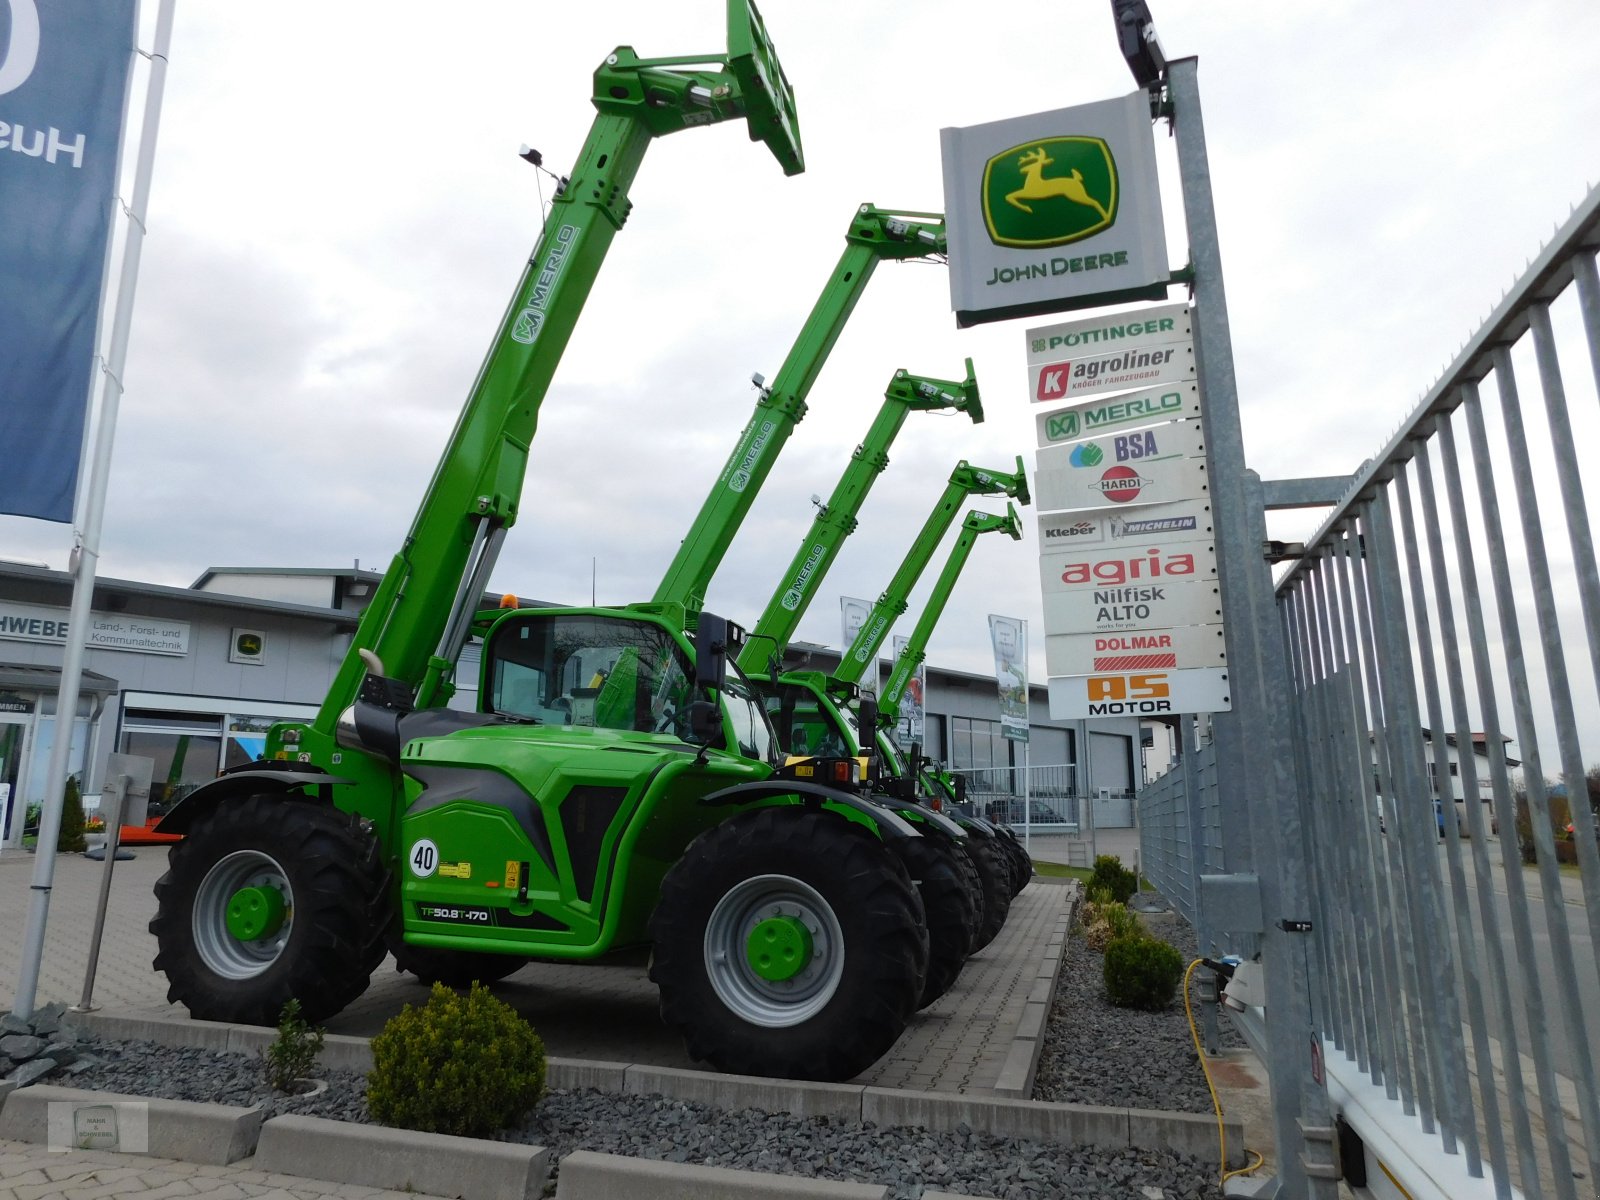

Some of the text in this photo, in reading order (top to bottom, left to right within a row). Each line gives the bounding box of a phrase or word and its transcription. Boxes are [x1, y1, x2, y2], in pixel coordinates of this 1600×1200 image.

[528, 224, 575, 308] MERLO
[986, 250, 1129, 286] JOHN DEERE
[1049, 318, 1175, 350] PÖTTINGER
[1073, 349, 1175, 379] agroliner
[1072, 370, 1160, 390] KRÖGER FAHRZEUGBAU
[1084, 392, 1182, 425] MERLO
[741, 421, 772, 472] MERLO
[1114, 430, 1158, 462] BSA
[1101, 478, 1140, 490] HARDI
[1045, 525, 1096, 538] Kleber
[1128, 518, 1193, 532] MICHELIN
[793, 544, 824, 591] MERLO
[1061, 548, 1194, 586] agria
[1094, 586, 1165, 604] Nilfisk
[1096, 604, 1150, 622] ALTO
[92, 632, 182, 650] Kommunaltechnik
[130, 624, 159, 636] Forst-
[162, 628, 181, 638] und
[863, 617, 885, 649] MERLO
[1095, 635, 1171, 651] DOLMAR
[1087, 673, 1170, 701] AS
[1088, 700, 1171, 715] MOTOR
[414, 846, 434, 870] 40
